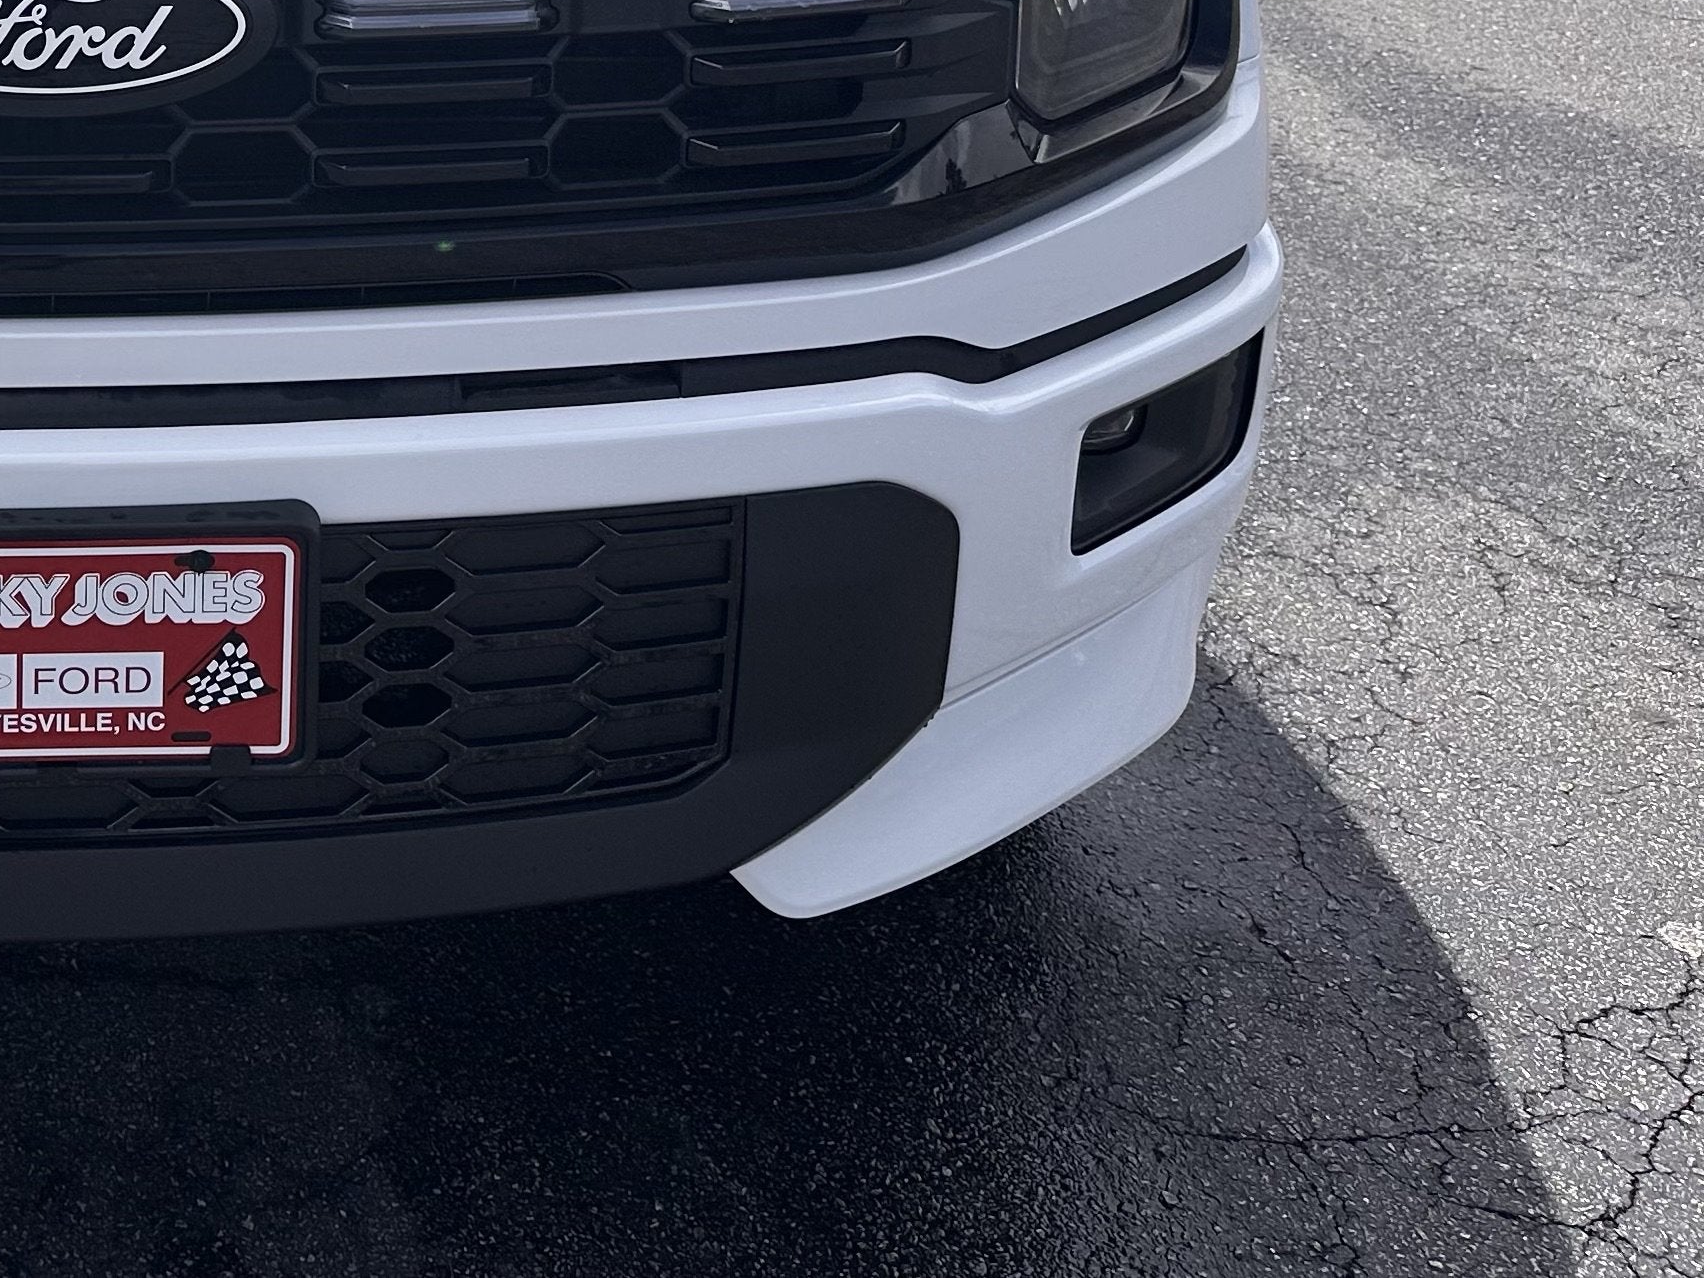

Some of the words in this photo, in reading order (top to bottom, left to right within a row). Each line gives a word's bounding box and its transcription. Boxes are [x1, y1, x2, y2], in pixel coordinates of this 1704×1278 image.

[61, 569, 266, 626] JONES
[33, 666, 152, 695] FORD
[127, 711, 166, 732] NC
